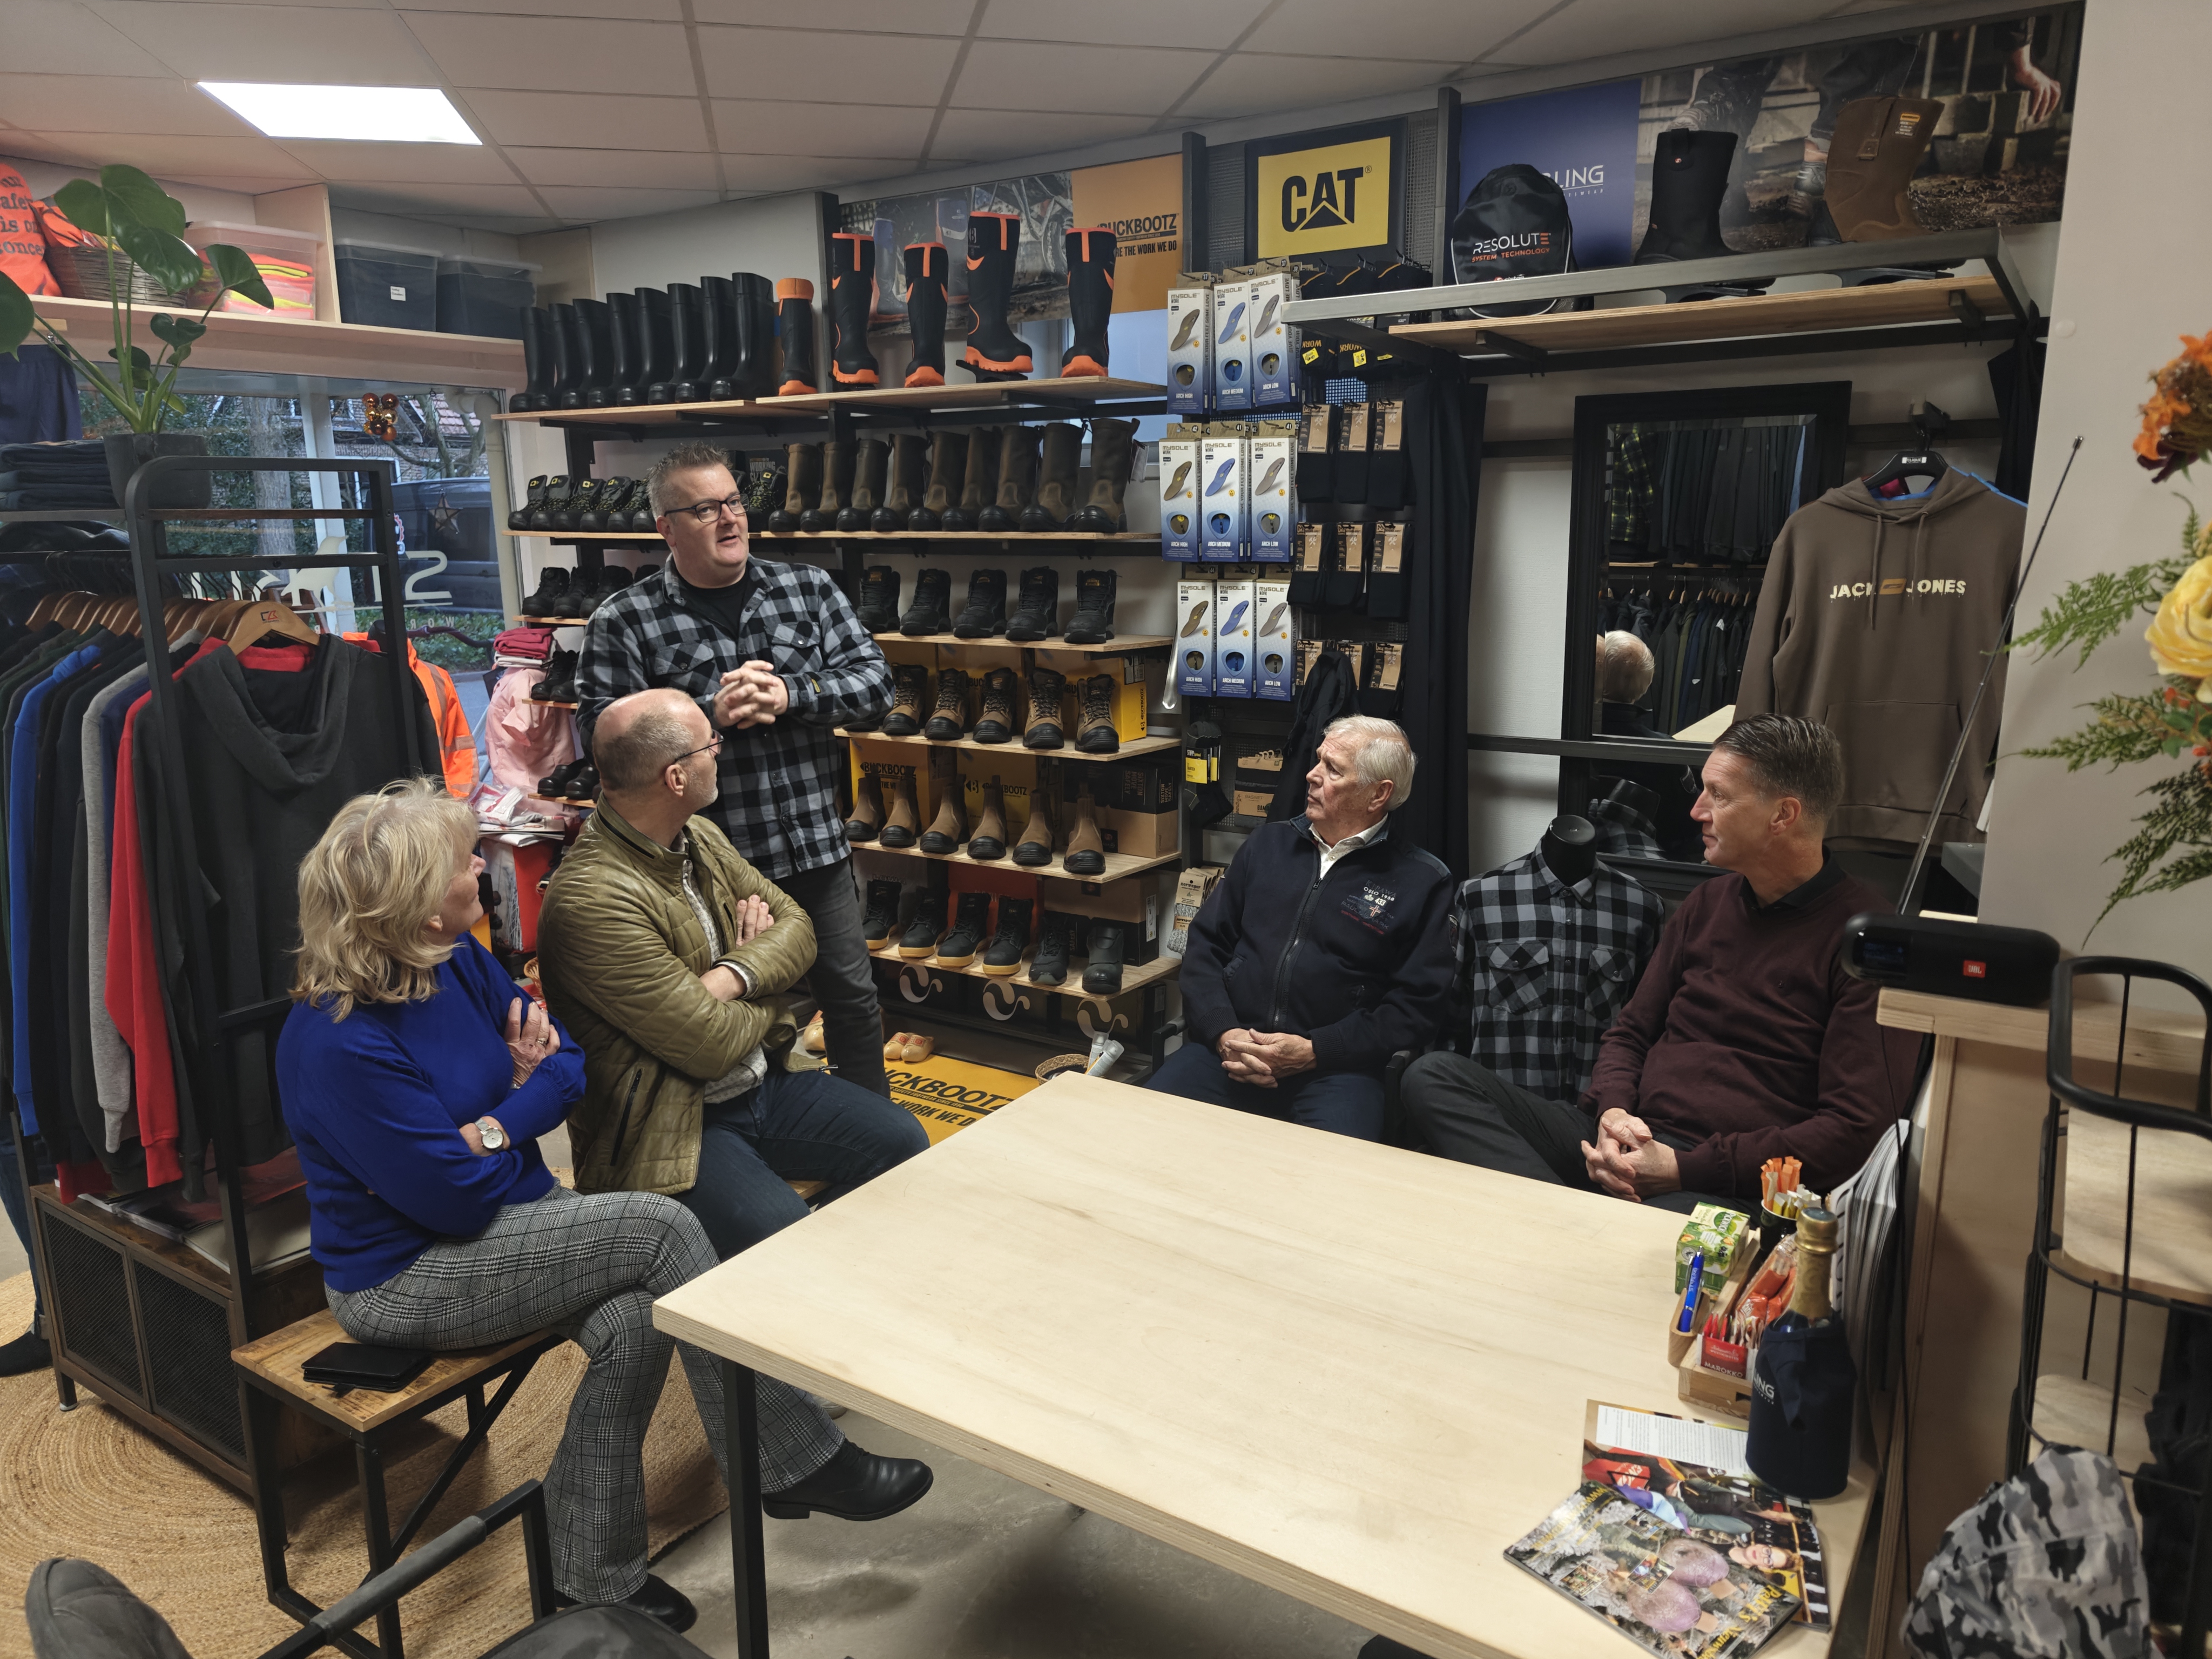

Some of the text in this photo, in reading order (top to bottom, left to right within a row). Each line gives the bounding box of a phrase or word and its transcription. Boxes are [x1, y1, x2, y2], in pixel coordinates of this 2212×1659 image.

[1545, 165, 1603, 188] LING
[1282, 167, 1363, 232] CAT
[1124, 246, 1136, 257] THE
[1137, 243, 1156, 255] WORK
[1157, 241, 1166, 252] WE
[1168, 240, 1177, 251] DO
[1473, 232, 1549, 254] RESOLUTE
[1472, 247, 1550, 263] SYSTEM TECHNOLOGY
[1251, 279, 1276, 288] MYSOLE
[1302, 340, 1322, 348] WORK
[1364, 887, 1379, 895] OSLO
[1375, 898, 1386, 906] 433
[1968, 965, 1982, 974] JBL
[893, 1087, 911, 1096] SAFETY
[911, 1091, 936, 1101] FOOTWEAR
[934, 1110, 966, 1123] WE
[956, 1117, 977, 1127] D
[1717, 1212, 1737, 1232] PICKWICK
[1704, 1361, 1743, 1378] MAROKKO
